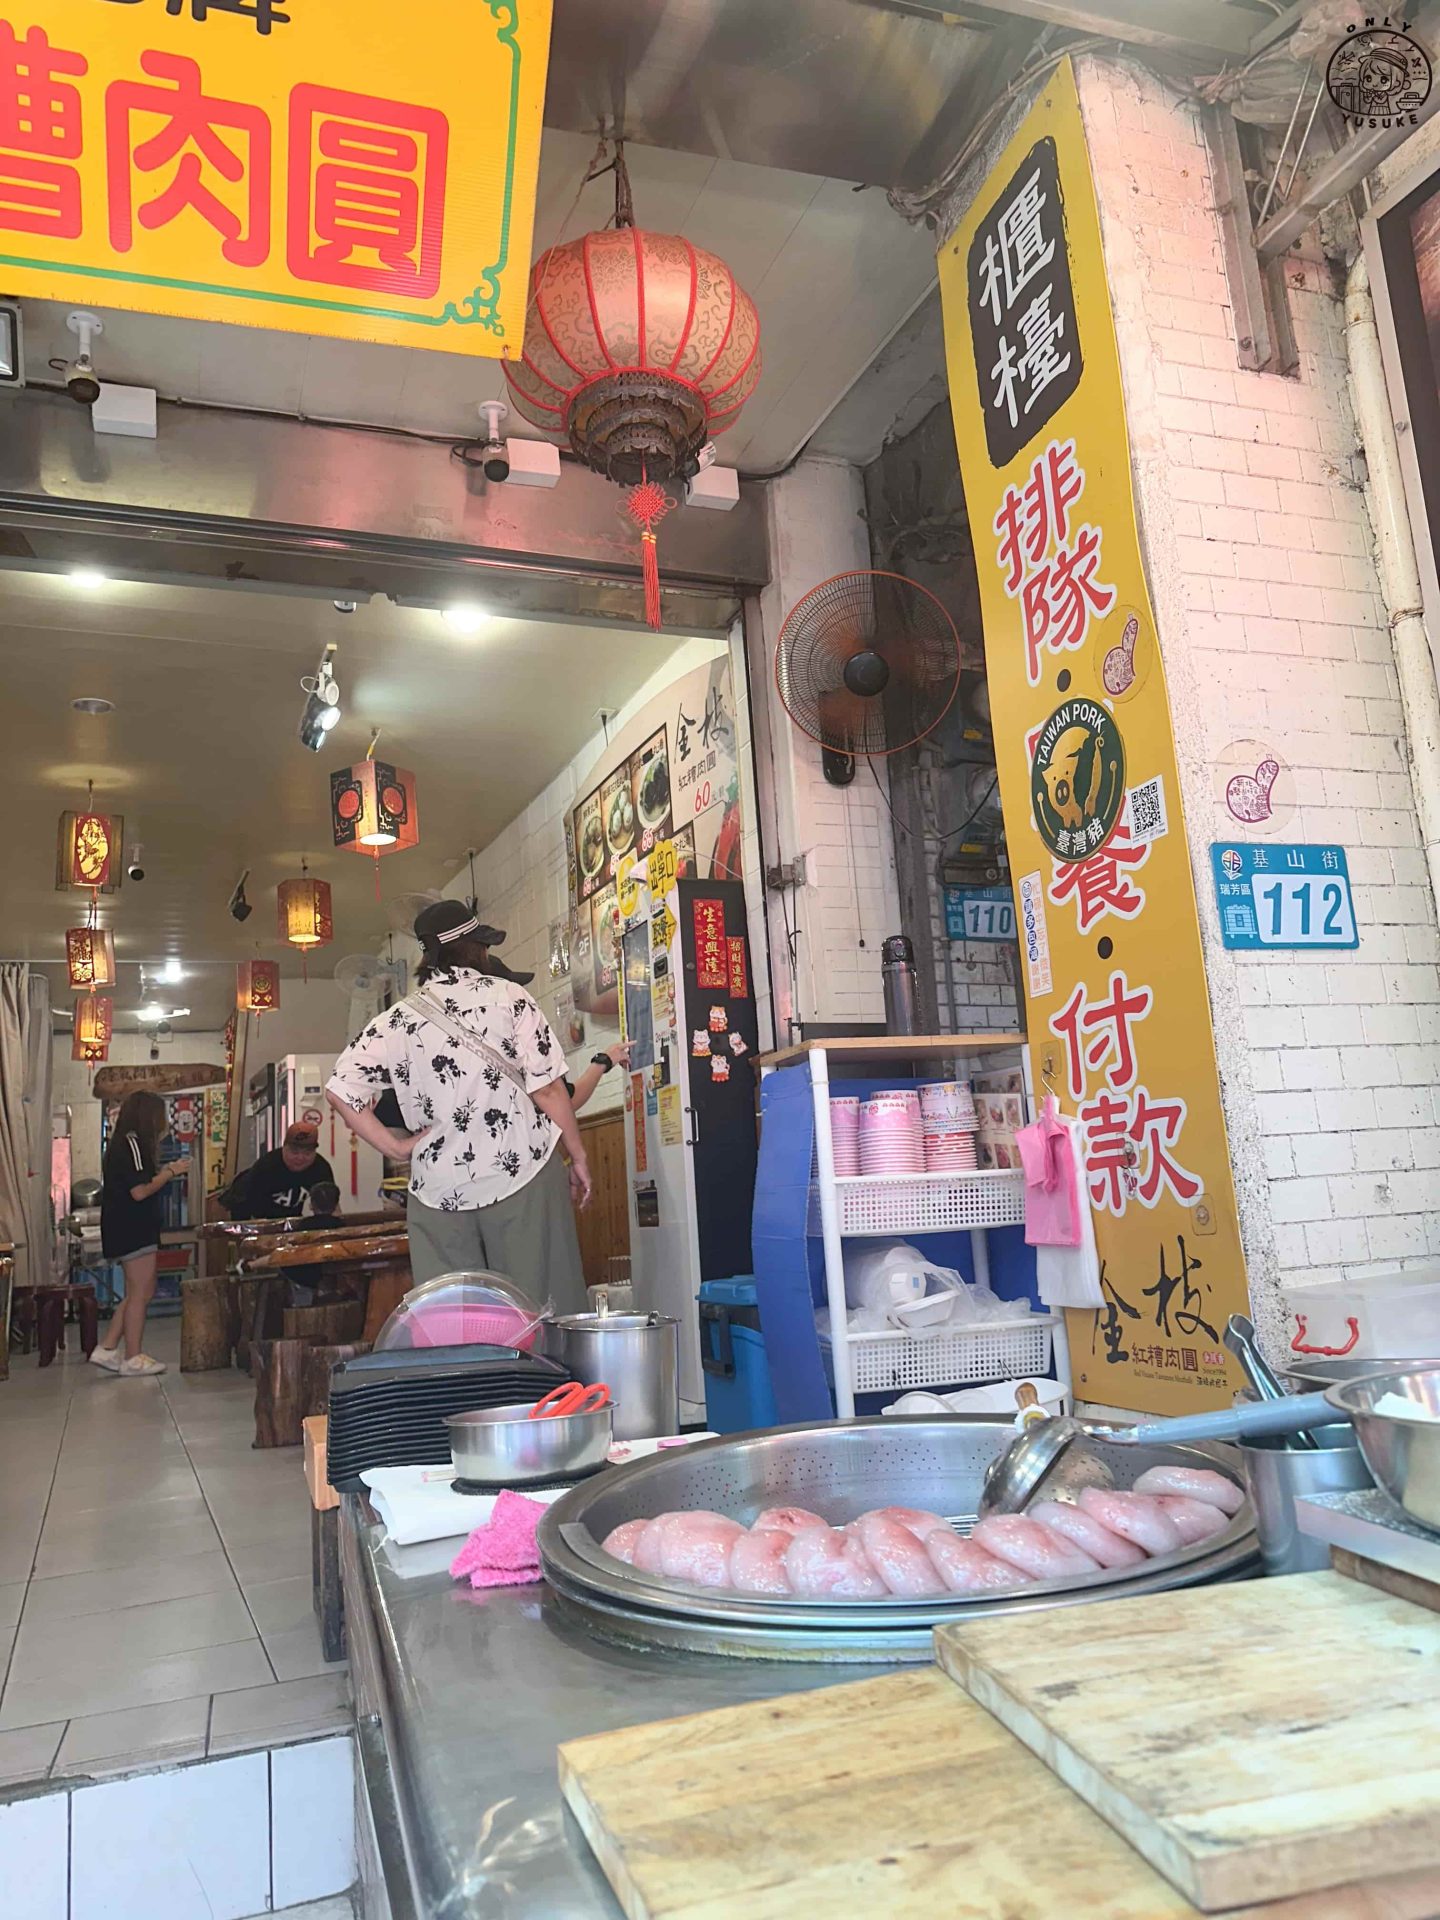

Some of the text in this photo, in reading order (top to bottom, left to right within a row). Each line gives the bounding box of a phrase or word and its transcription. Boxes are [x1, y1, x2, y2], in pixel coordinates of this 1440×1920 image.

[995, 441, 1116, 684] 排隊
[1036, 703, 1106, 766] TAIWAN PORK
[694, 780, 710, 812] 60
[1056, 817, 1105, 855] 臺灣豬
[1252, 848, 1339, 869] 基山街
[1219, 883, 1251, 896] 瑞芳區
[969, 905, 1012, 933] 110
[1263, 882, 1343, 935] 112
[579, 936, 590, 956] 2F
[702, 906, 720, 974] 生意興隆
[1050, 973, 1201, 1213] 付款
[1131, 1342, 1199, 1372] 紅糟肉圓
